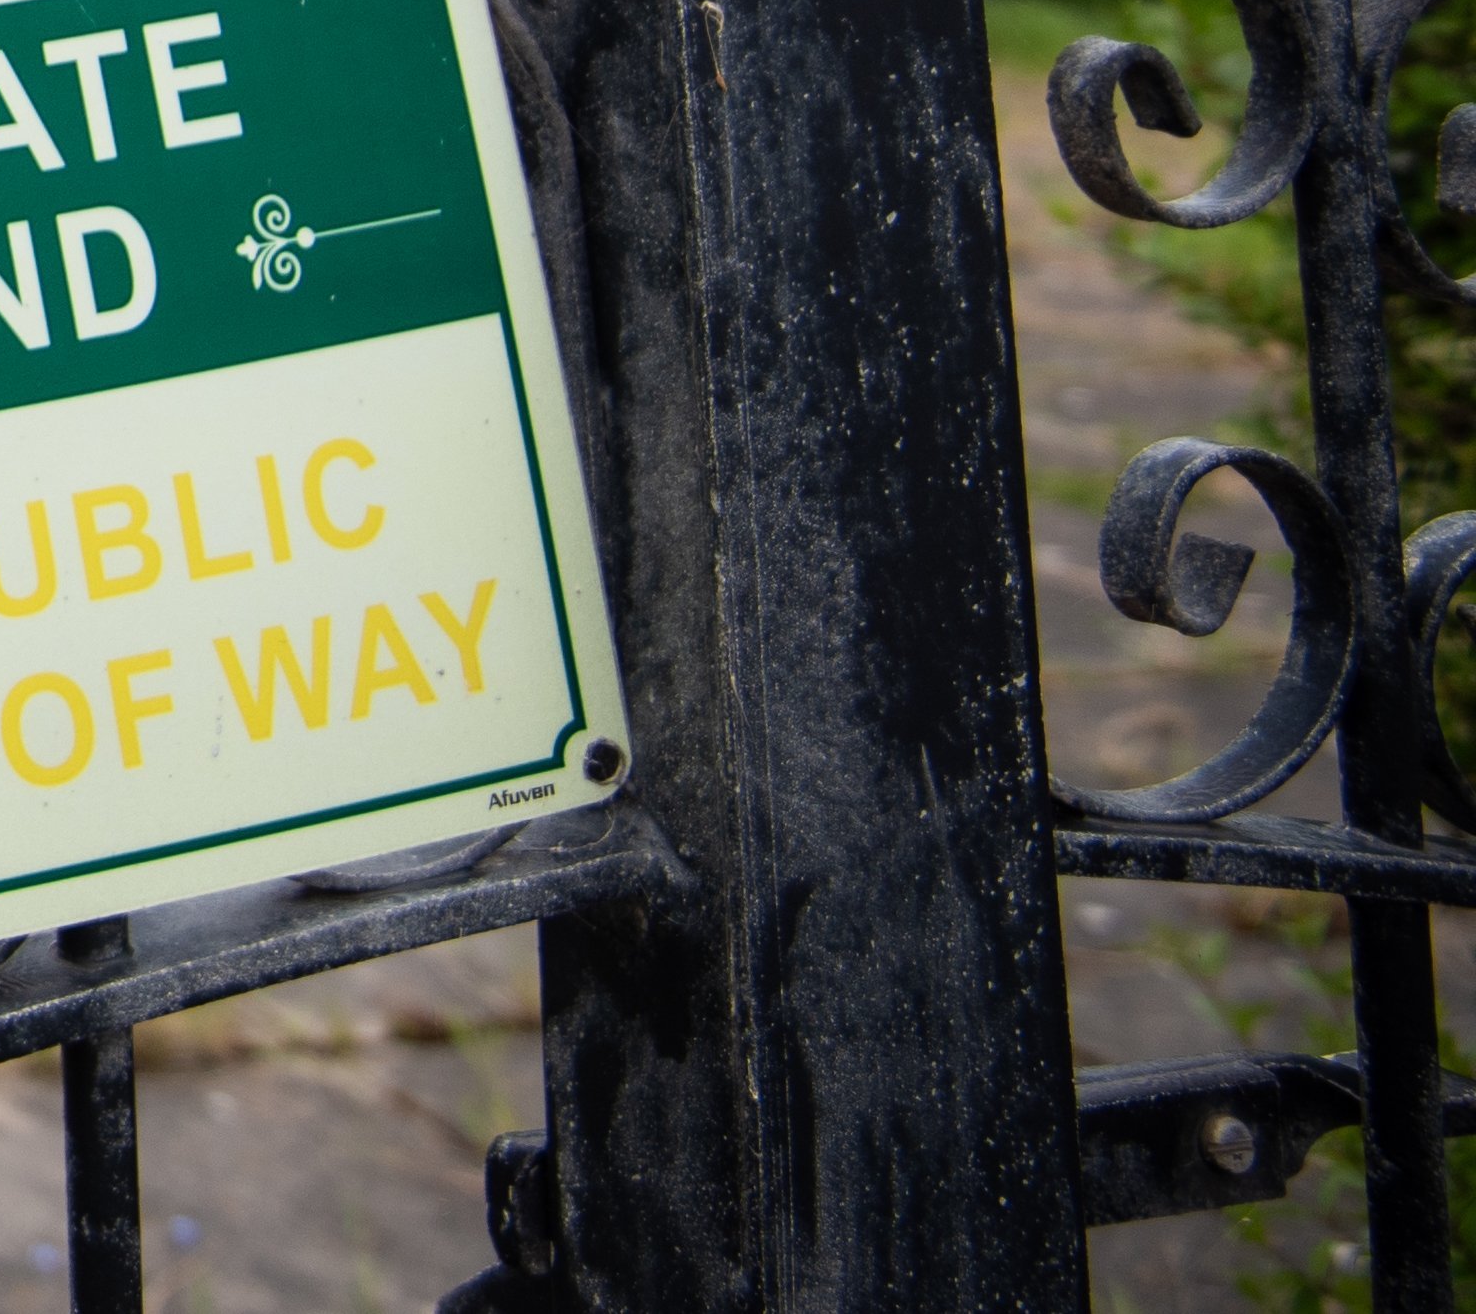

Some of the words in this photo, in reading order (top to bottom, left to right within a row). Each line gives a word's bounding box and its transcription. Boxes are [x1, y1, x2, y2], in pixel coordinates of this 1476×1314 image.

[0, 648, 177, 790] OF
[212, 578, 500, 744] WAY
[488, 782, 556, 811] Afuven
